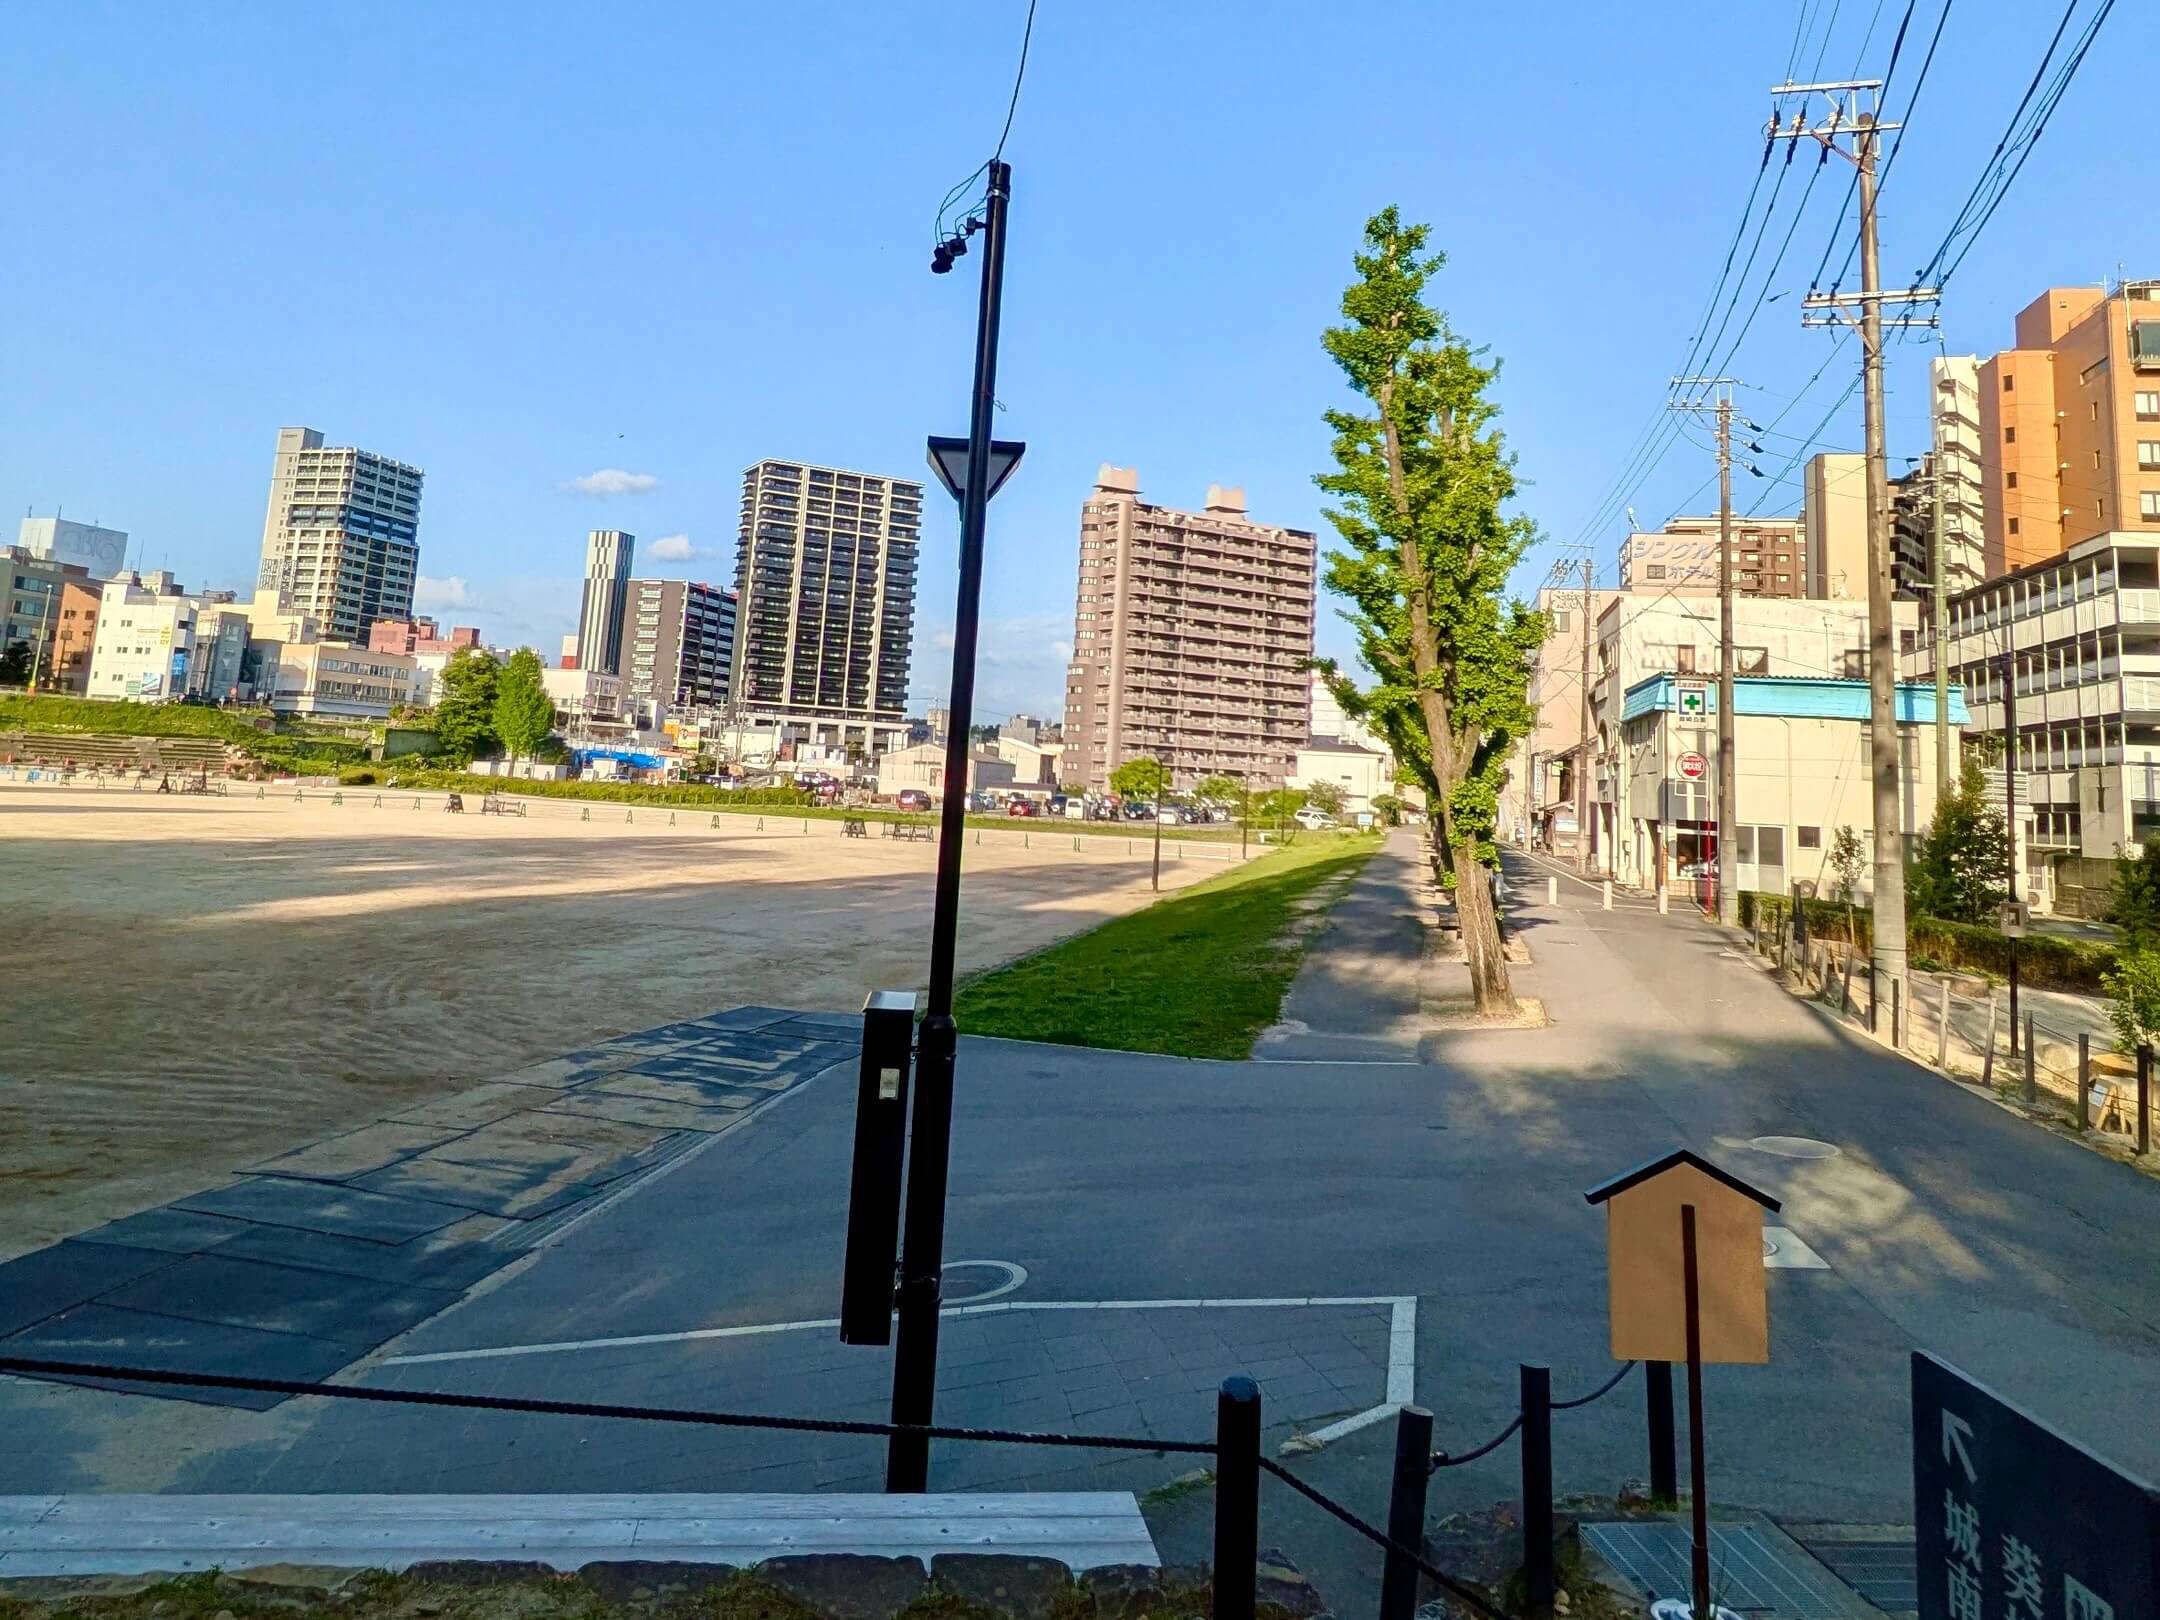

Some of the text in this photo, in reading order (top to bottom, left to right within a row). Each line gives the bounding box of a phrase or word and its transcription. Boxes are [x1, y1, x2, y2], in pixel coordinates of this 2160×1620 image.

[1632, 540, 1716, 560] シングル
[1667, 565, 1716, 580] ホテル
[2001, 1533, 2044, 1620] 葵
